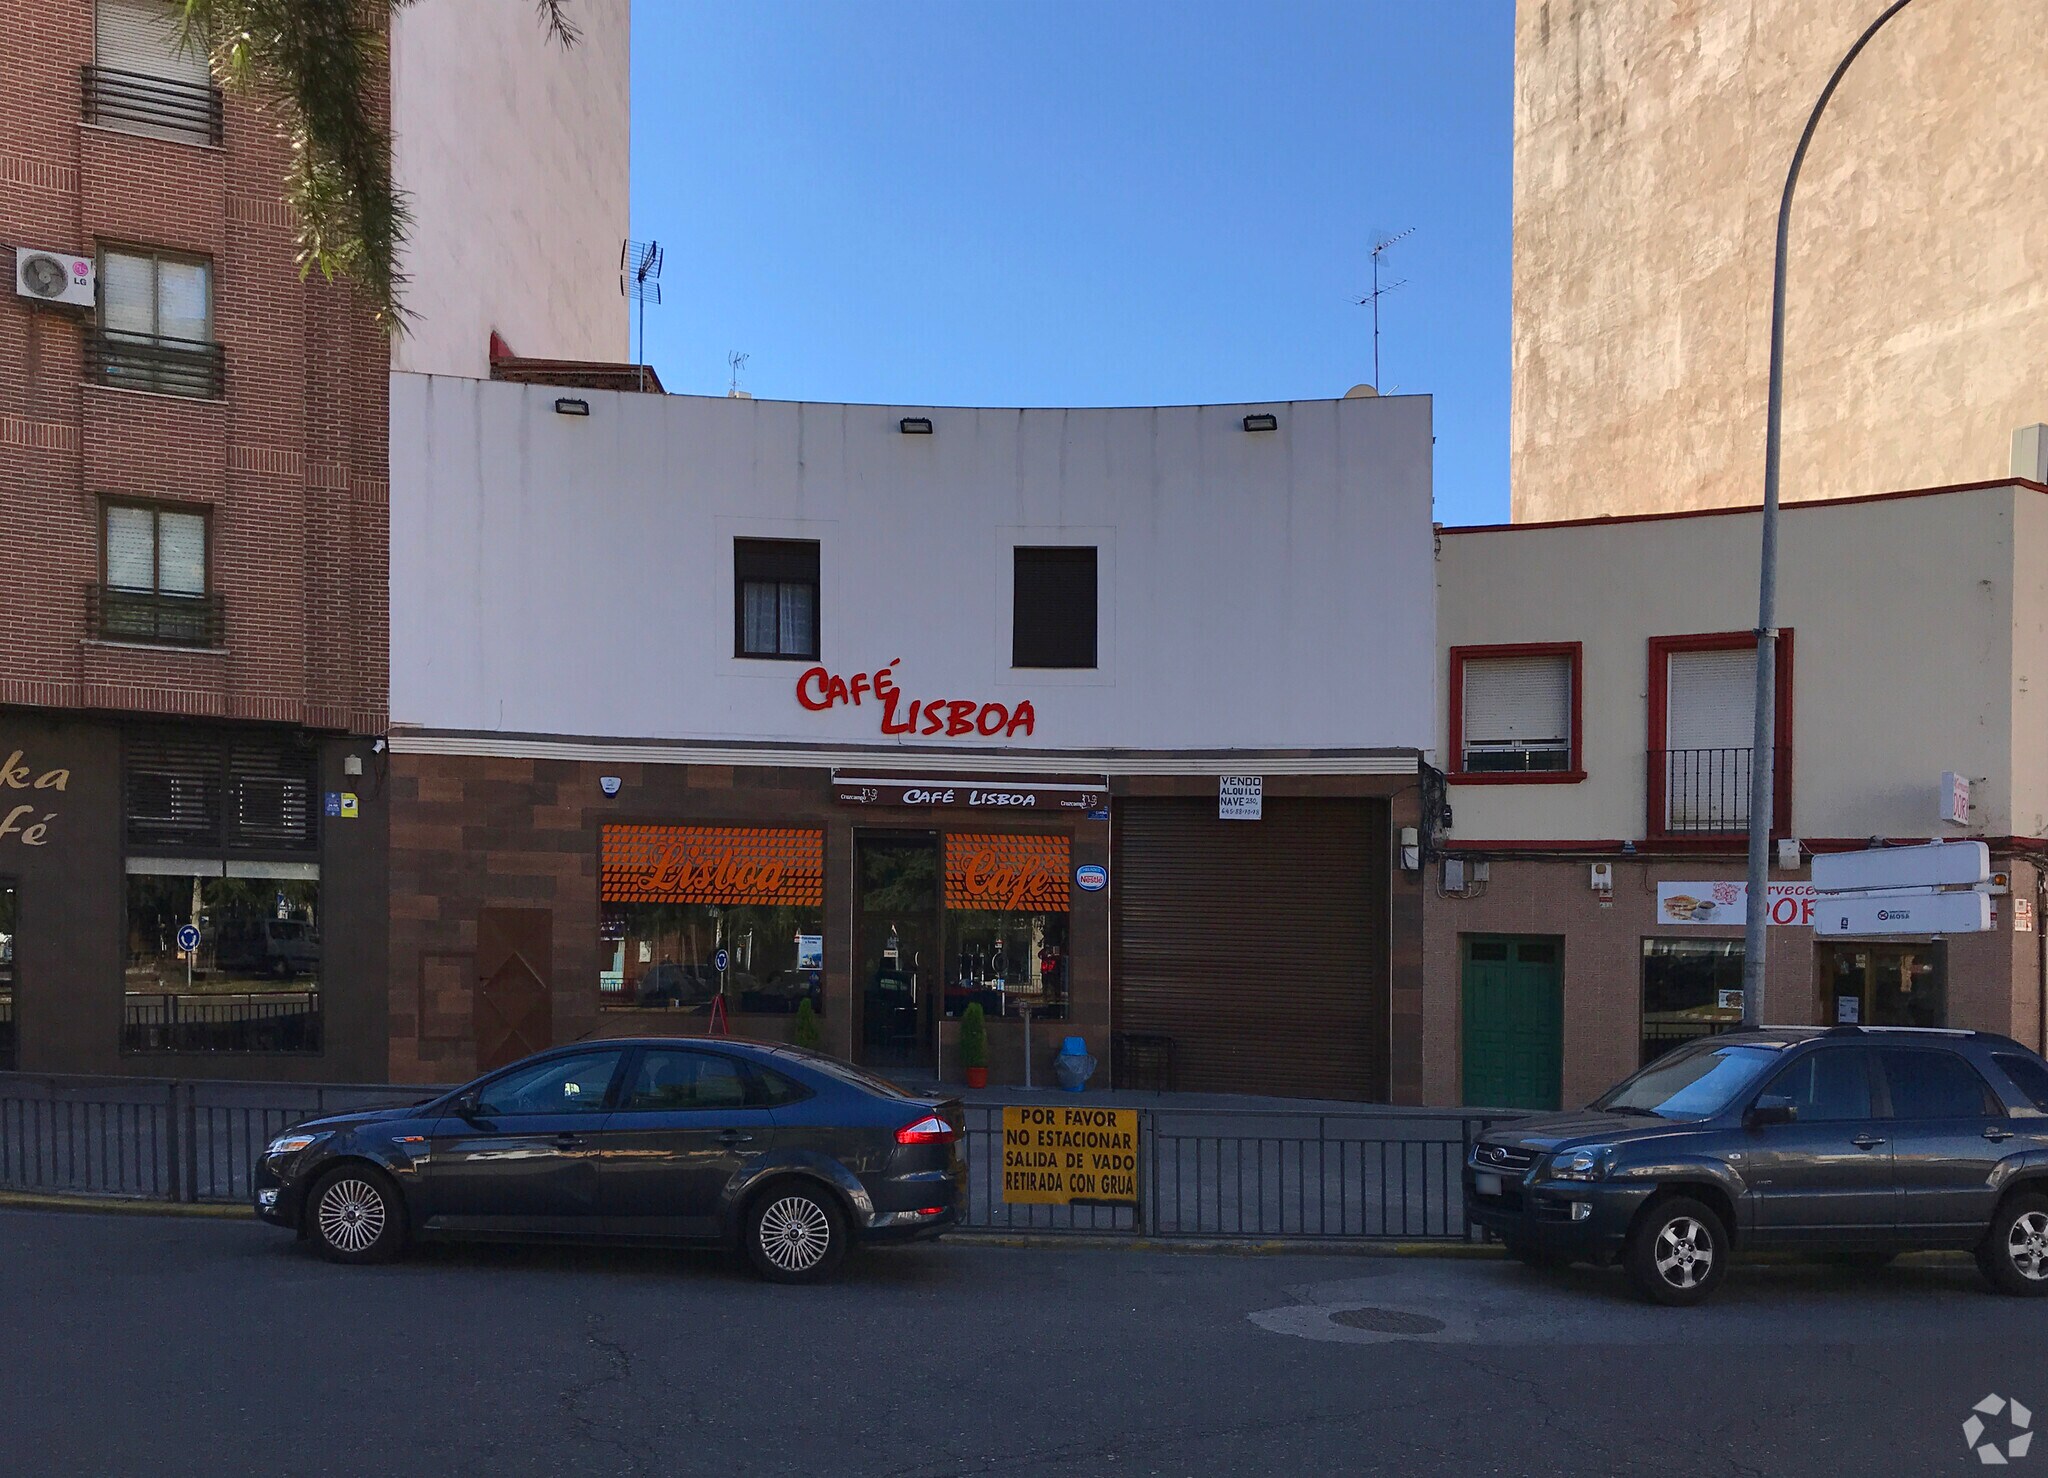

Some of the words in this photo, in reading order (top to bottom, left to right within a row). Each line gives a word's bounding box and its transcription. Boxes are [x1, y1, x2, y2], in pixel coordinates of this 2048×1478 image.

[74, 278, 87, 286] LG
[796, 658, 901, 711] CAFÉ
[881, 687, 1036, 738] LISBOA
[1222, 777, 1261, 786] VENDO
[903, 788, 955, 804] CAFÉ
[968, 789, 1036, 807] LISBOA
[1221, 788, 1260, 796] ALQUILO
[1221, 797, 1245, 806] NAVE
[636, 840, 786, 893] Lisboa
[960, 847, 1056, 911] Café
[1021, 1109, 1055, 1125] POR
[1065, 1110, 1117, 1127] FAVOR
[1006, 1129, 1030, 1146] NO
[1038, 1130, 1132, 1149] ESTACIONAR
[1006, 1151, 1058, 1168] SALIDA
[1066, 1152, 1084, 1169] DE
[1092, 1153, 1135, 1171] VADO
[1006, 1171, 1063, 1191] RETIRADA
[1069, 1173, 1095, 1193] CON
[1101, 1175, 1134, 1195] GRUA
